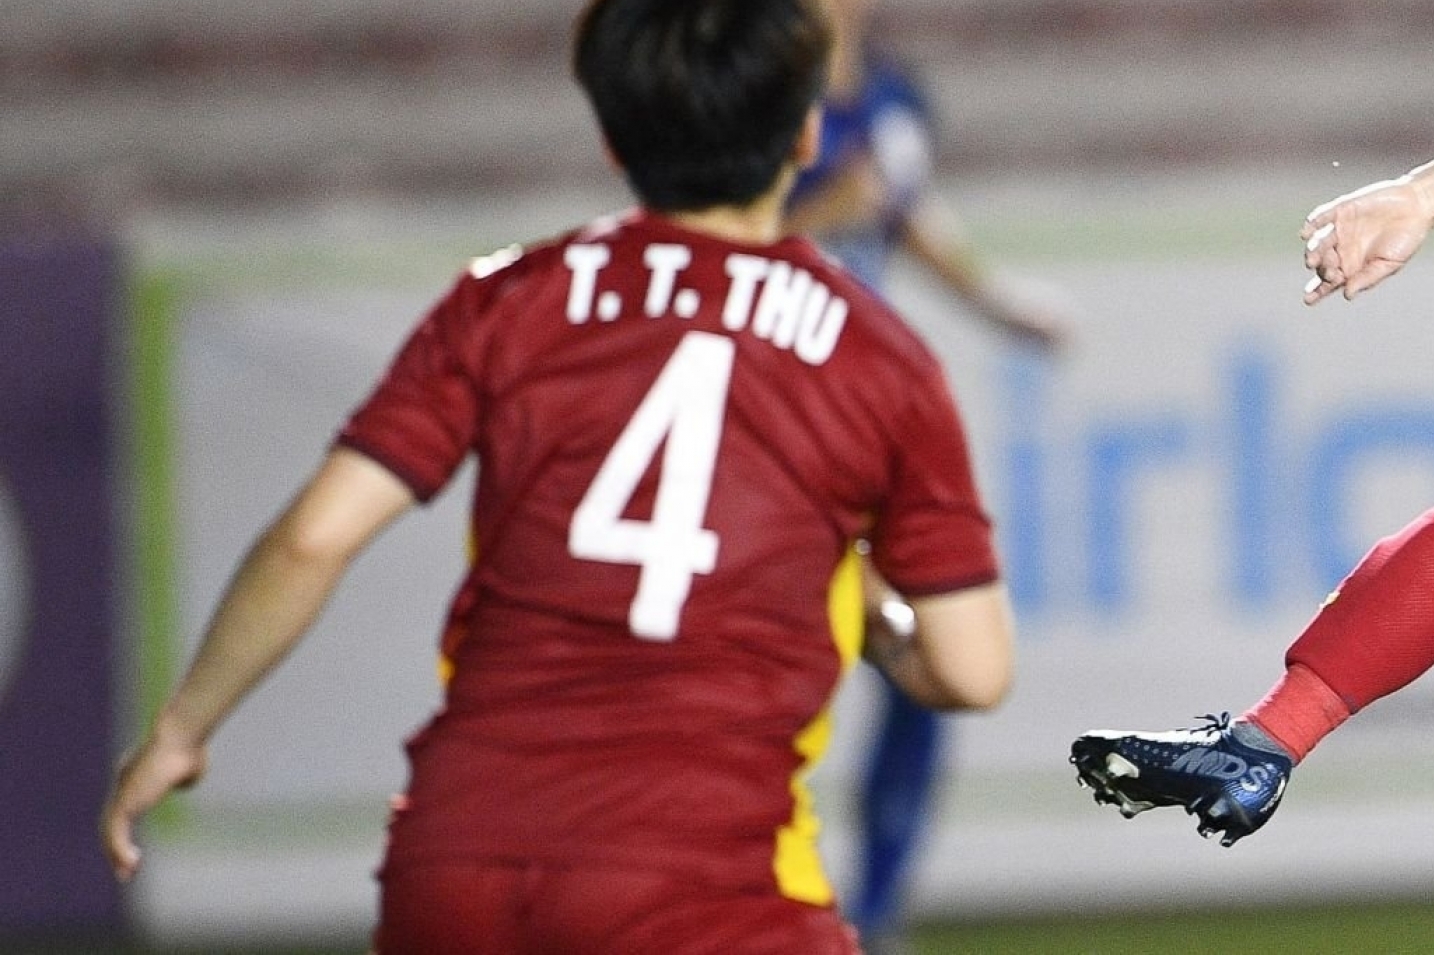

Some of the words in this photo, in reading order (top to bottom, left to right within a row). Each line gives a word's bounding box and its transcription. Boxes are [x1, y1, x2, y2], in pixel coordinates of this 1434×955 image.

[563, 243, 622, 325] T.
[643, 243, 701, 319] T.
[721, 253, 849, 366] THU
[567, 331, 736, 642] 4
